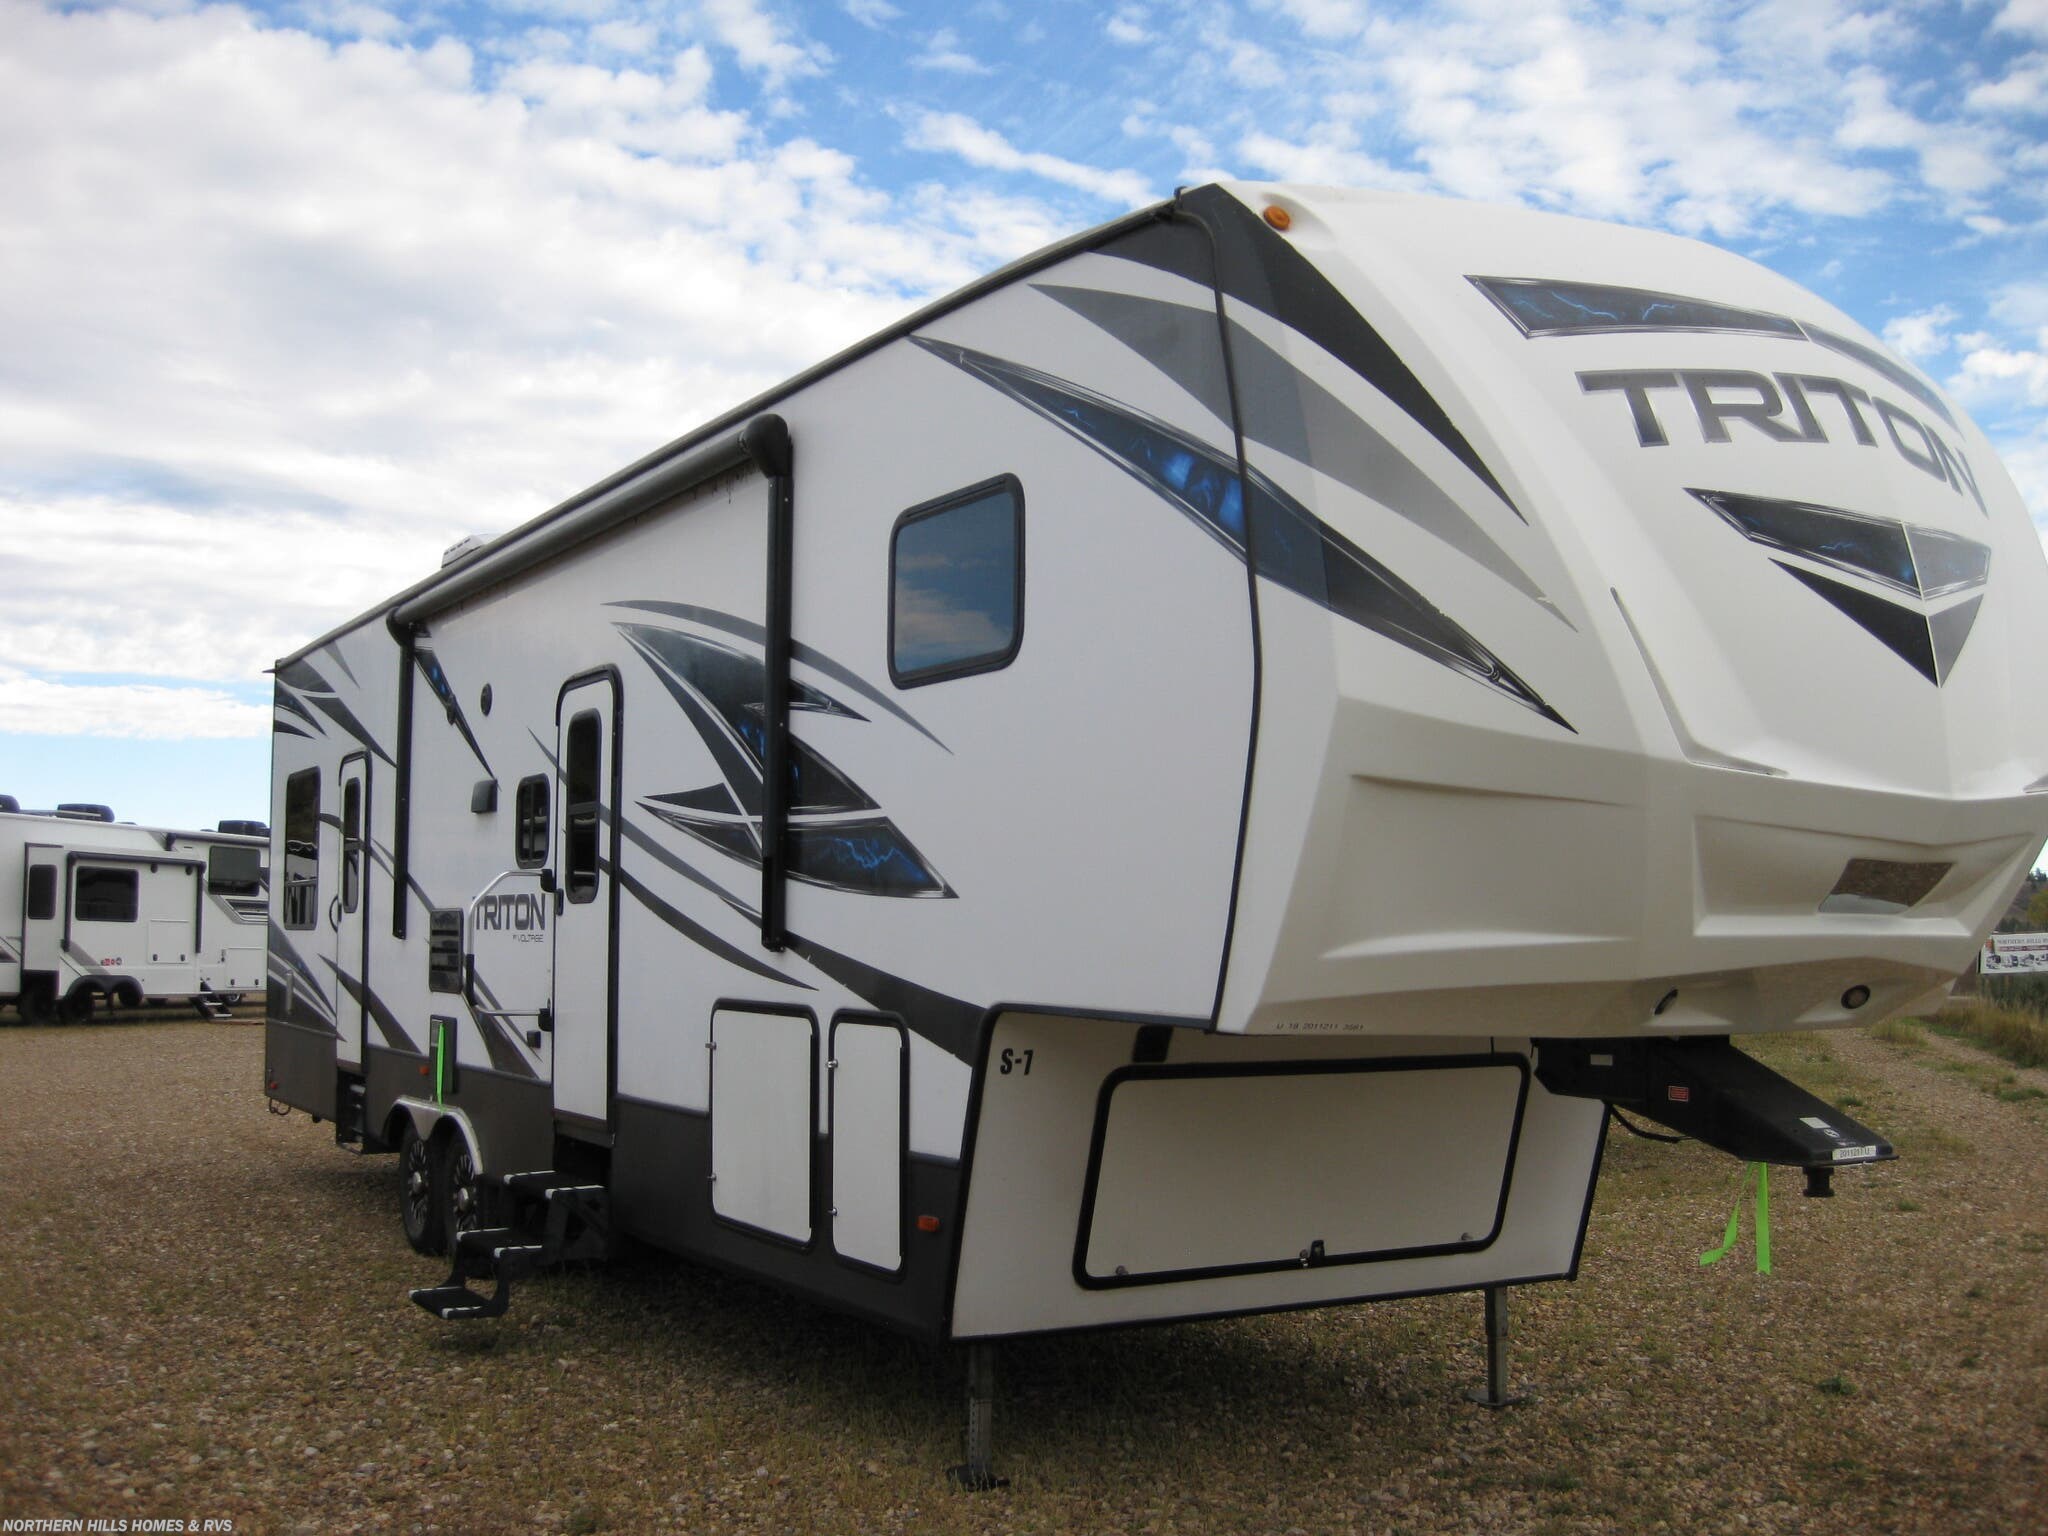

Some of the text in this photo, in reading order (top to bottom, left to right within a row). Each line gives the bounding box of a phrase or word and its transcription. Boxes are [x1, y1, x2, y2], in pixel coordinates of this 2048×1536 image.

[1575, 368, 1989, 519] TRITON
[472, 893, 546, 931] TRITON
[1000, 1048, 1034, 1075] S-7
